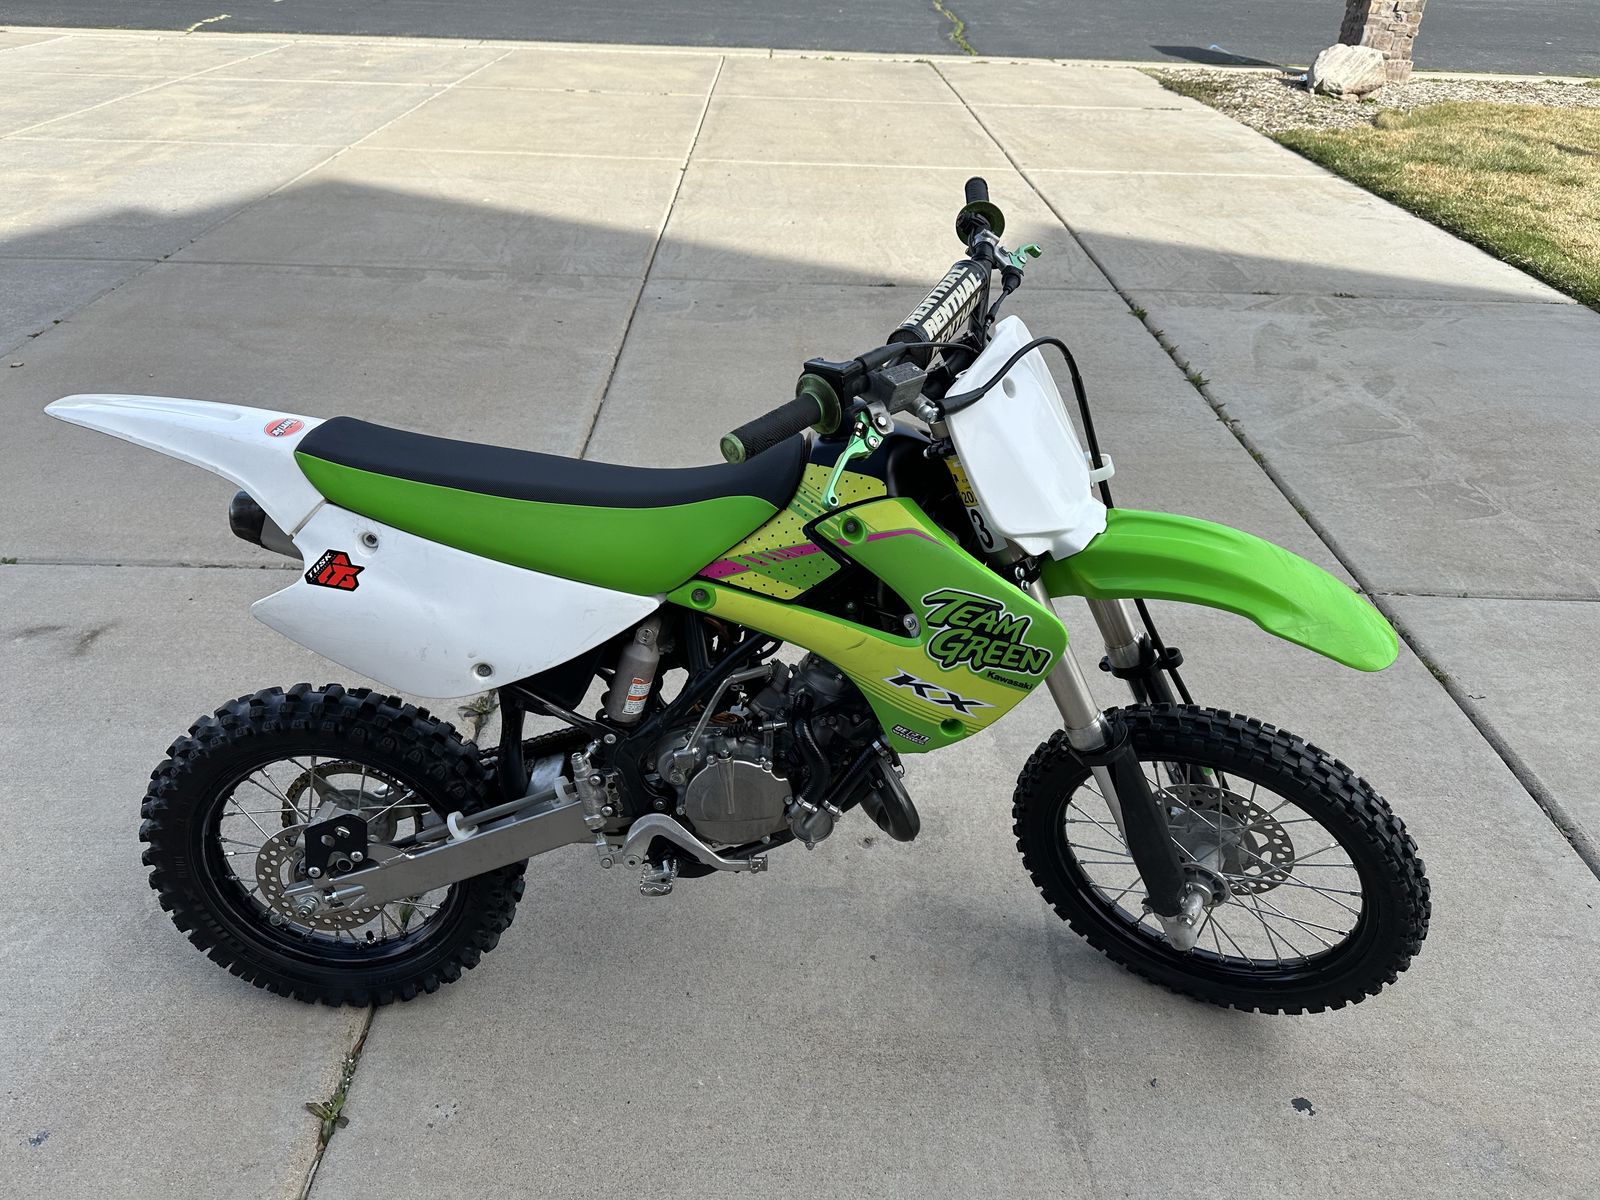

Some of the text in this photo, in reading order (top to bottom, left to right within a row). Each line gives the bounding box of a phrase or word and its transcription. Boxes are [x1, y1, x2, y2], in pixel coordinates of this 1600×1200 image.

[905, 267, 968, 326] RENTHAL
[922, 273, 982, 341] RENTHAL
[307, 552, 332, 578] TUSK
[922, 588, 1031, 644] TEAM
[927, 628, 1052, 675] GREEN
[884, 669, 993, 717] KX
[987, 670, 1033, 690] Kawasaki
